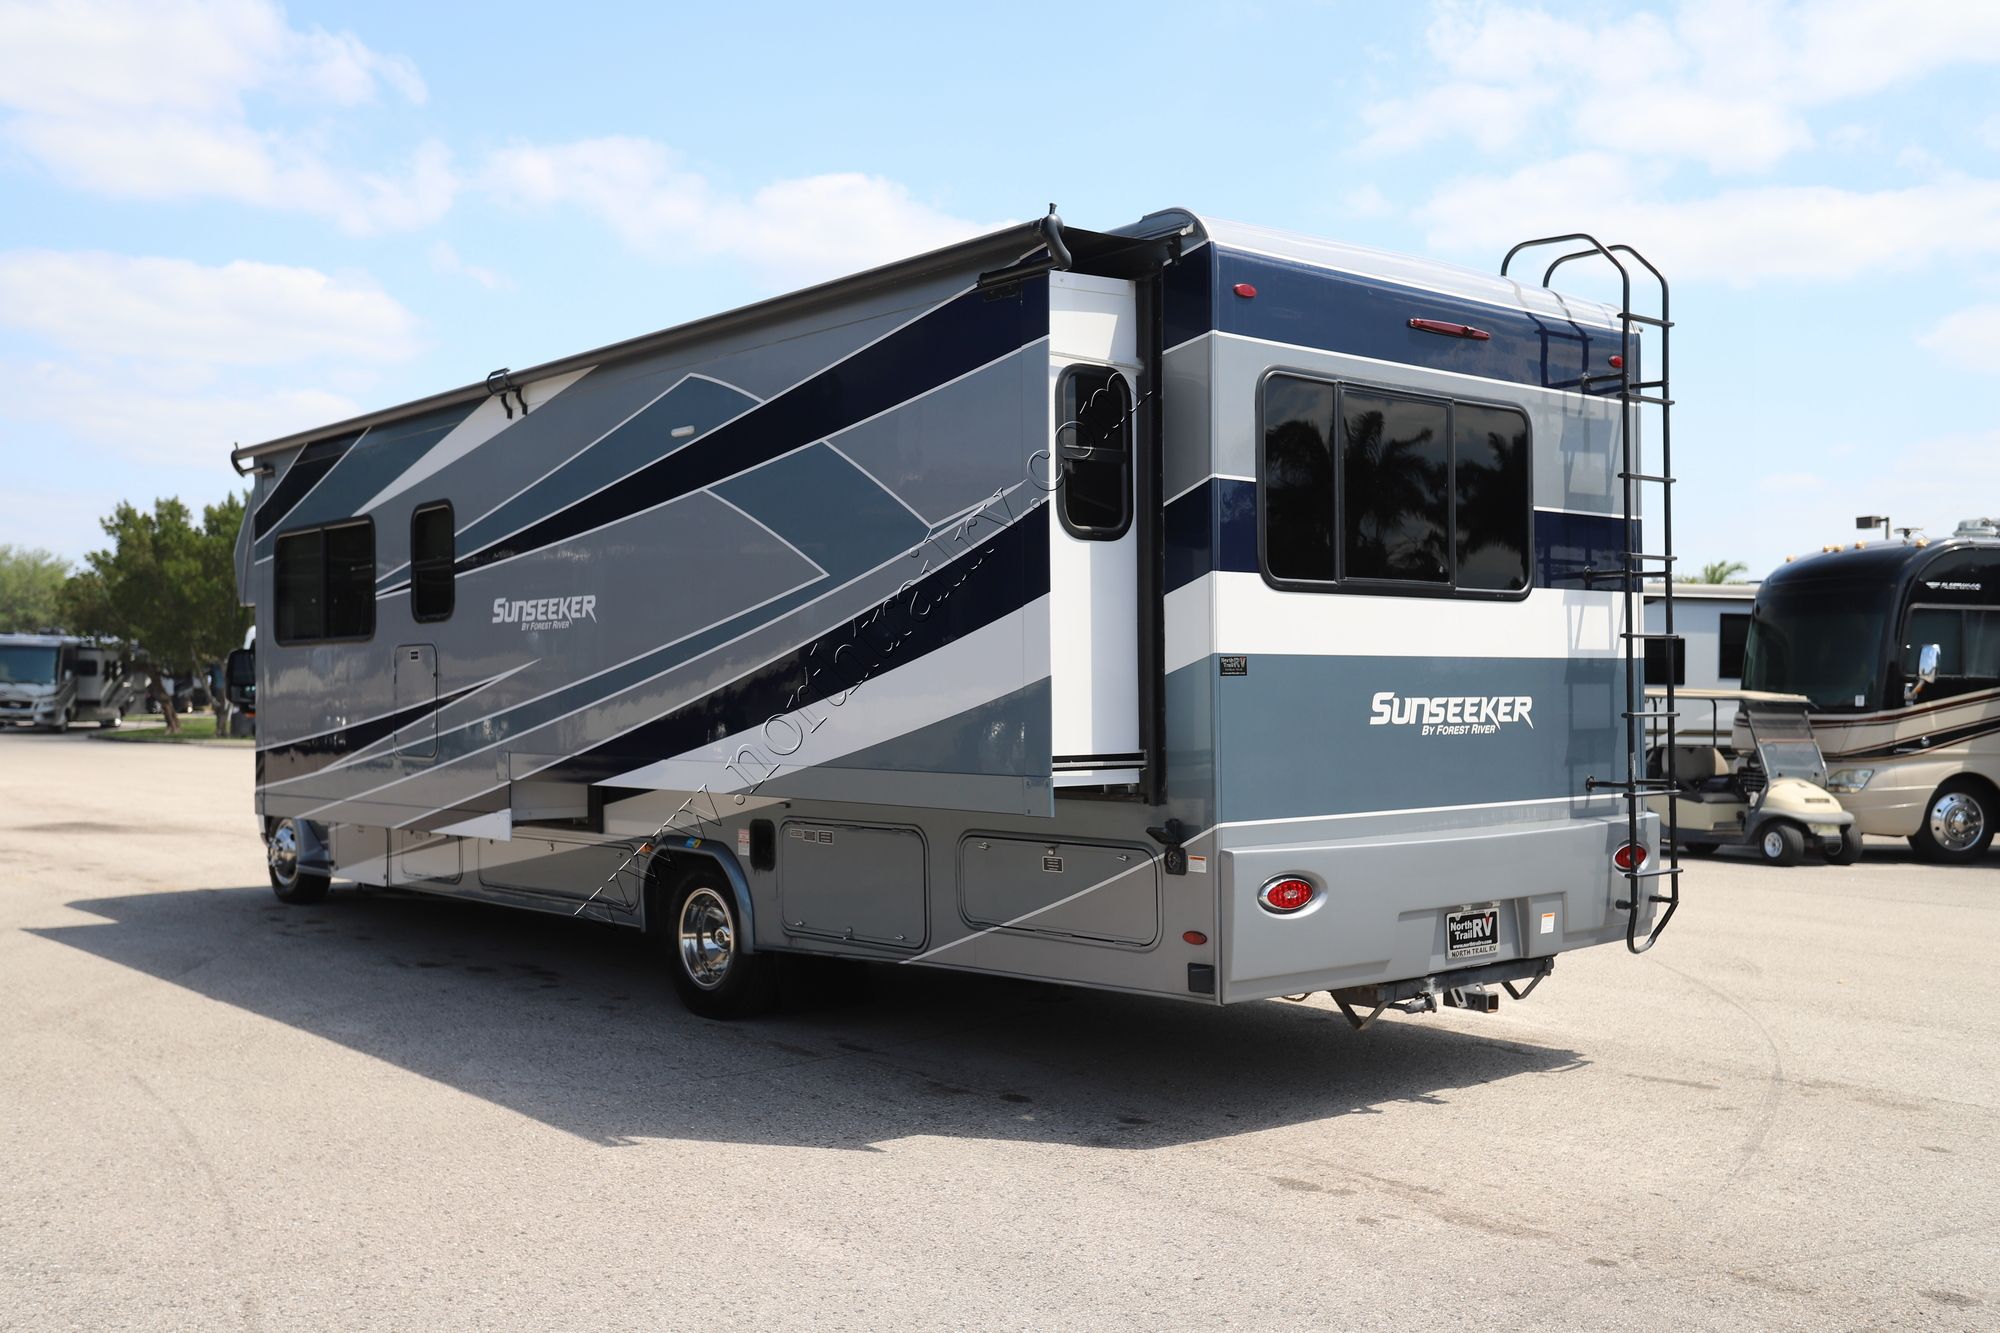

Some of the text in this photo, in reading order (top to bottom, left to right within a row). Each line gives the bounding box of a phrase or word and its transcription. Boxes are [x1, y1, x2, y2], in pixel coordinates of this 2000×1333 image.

[1233, 657, 1246, 668] RV
[1450, 920, 1472, 932] North
[1472, 916, 1494, 939] RV
[1454, 929, 1472, 941] Trail
[1451, 949, 1471, 958] NORTH
[1472, 947, 1488, 955] TRAIL
